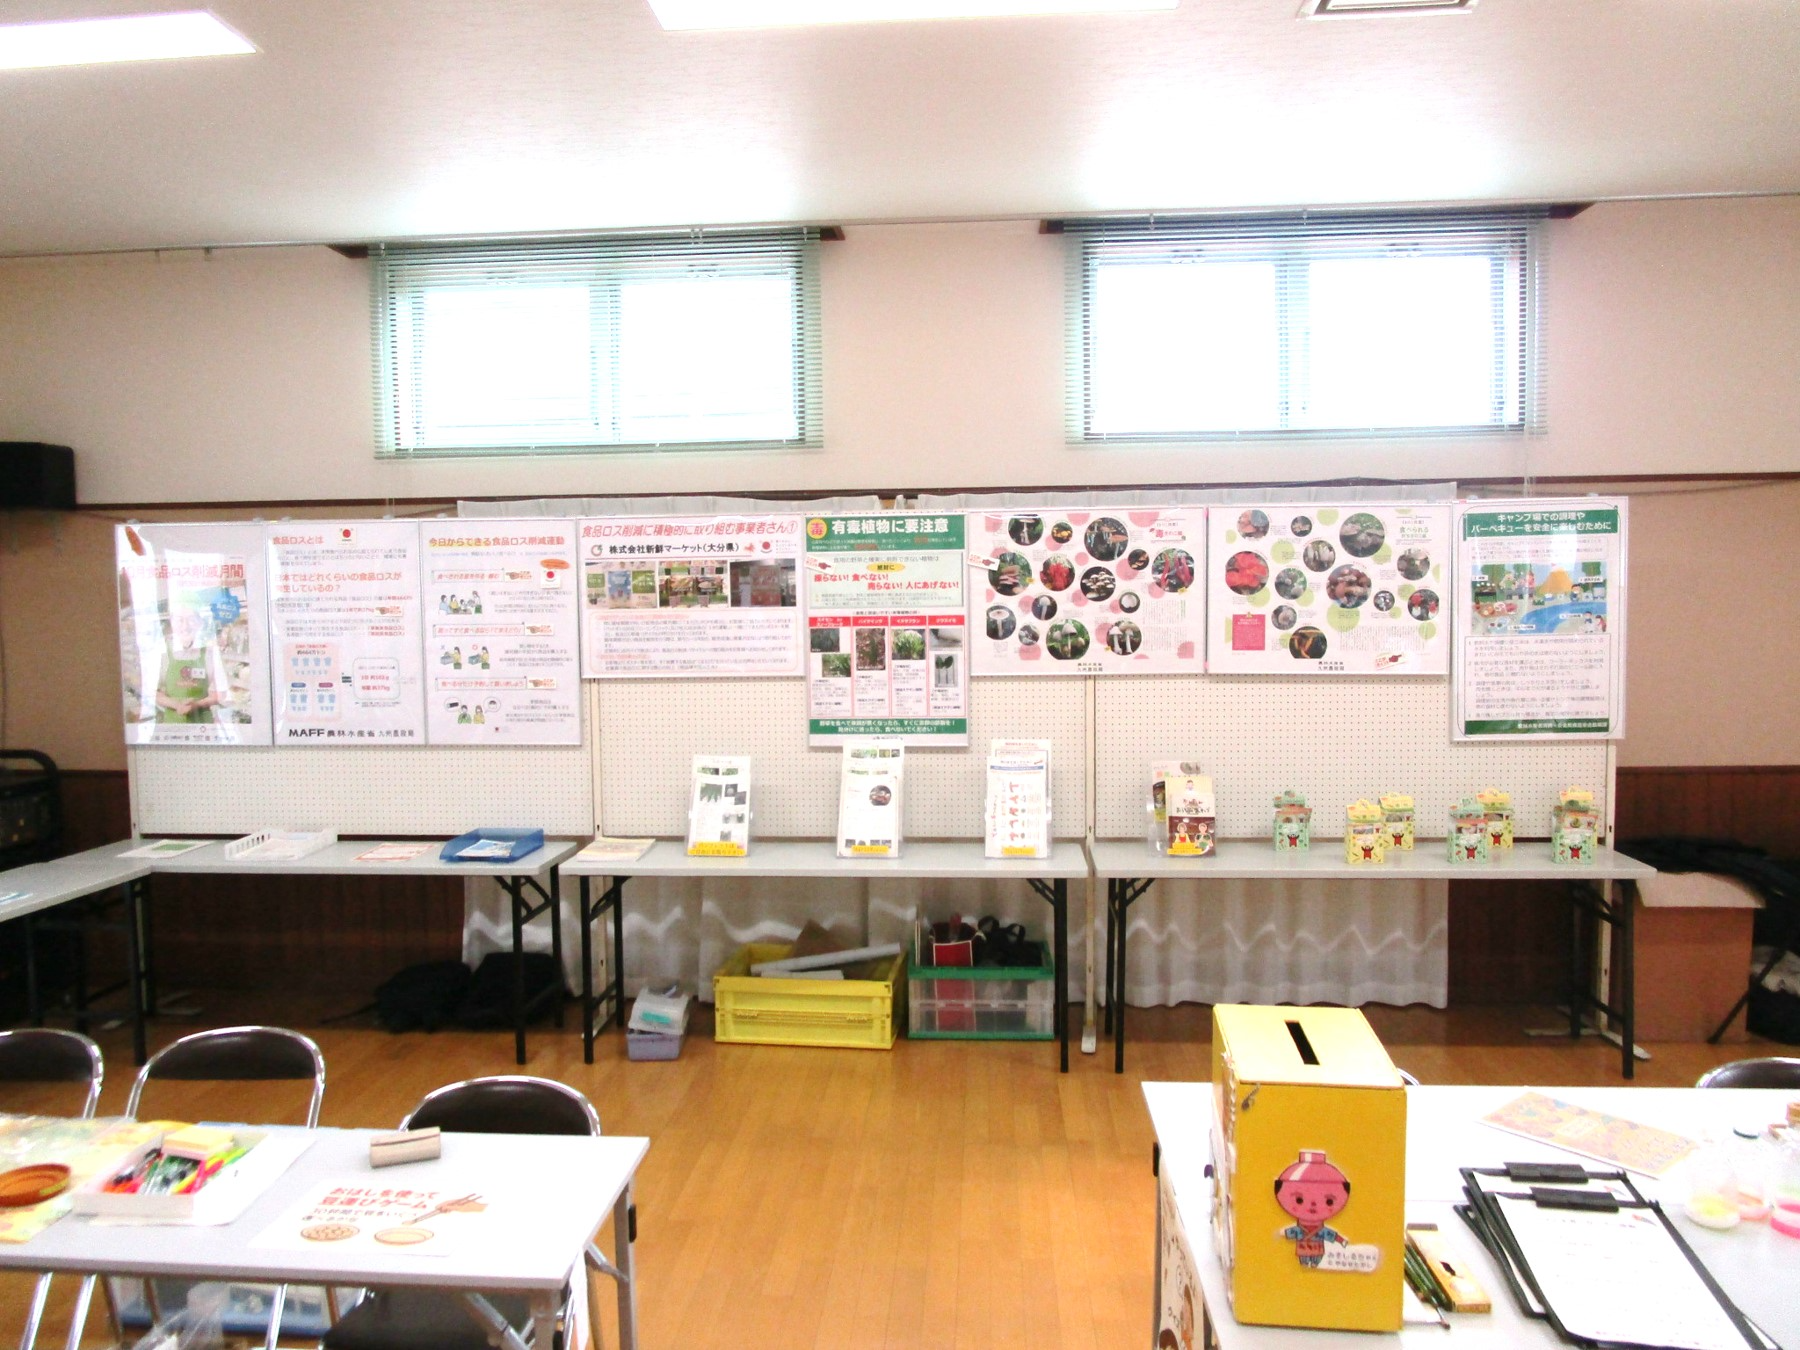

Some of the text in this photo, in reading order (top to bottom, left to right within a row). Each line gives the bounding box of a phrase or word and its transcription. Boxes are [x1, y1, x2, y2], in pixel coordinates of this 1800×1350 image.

[832, 518, 949, 535] 有毒植物に要注意
[272, 536, 324, 545] 食品ロスとは
[429, 536, 565, 547] 今日からできる食品ロス削減運動
[288, 728, 325, 738] MAFF
